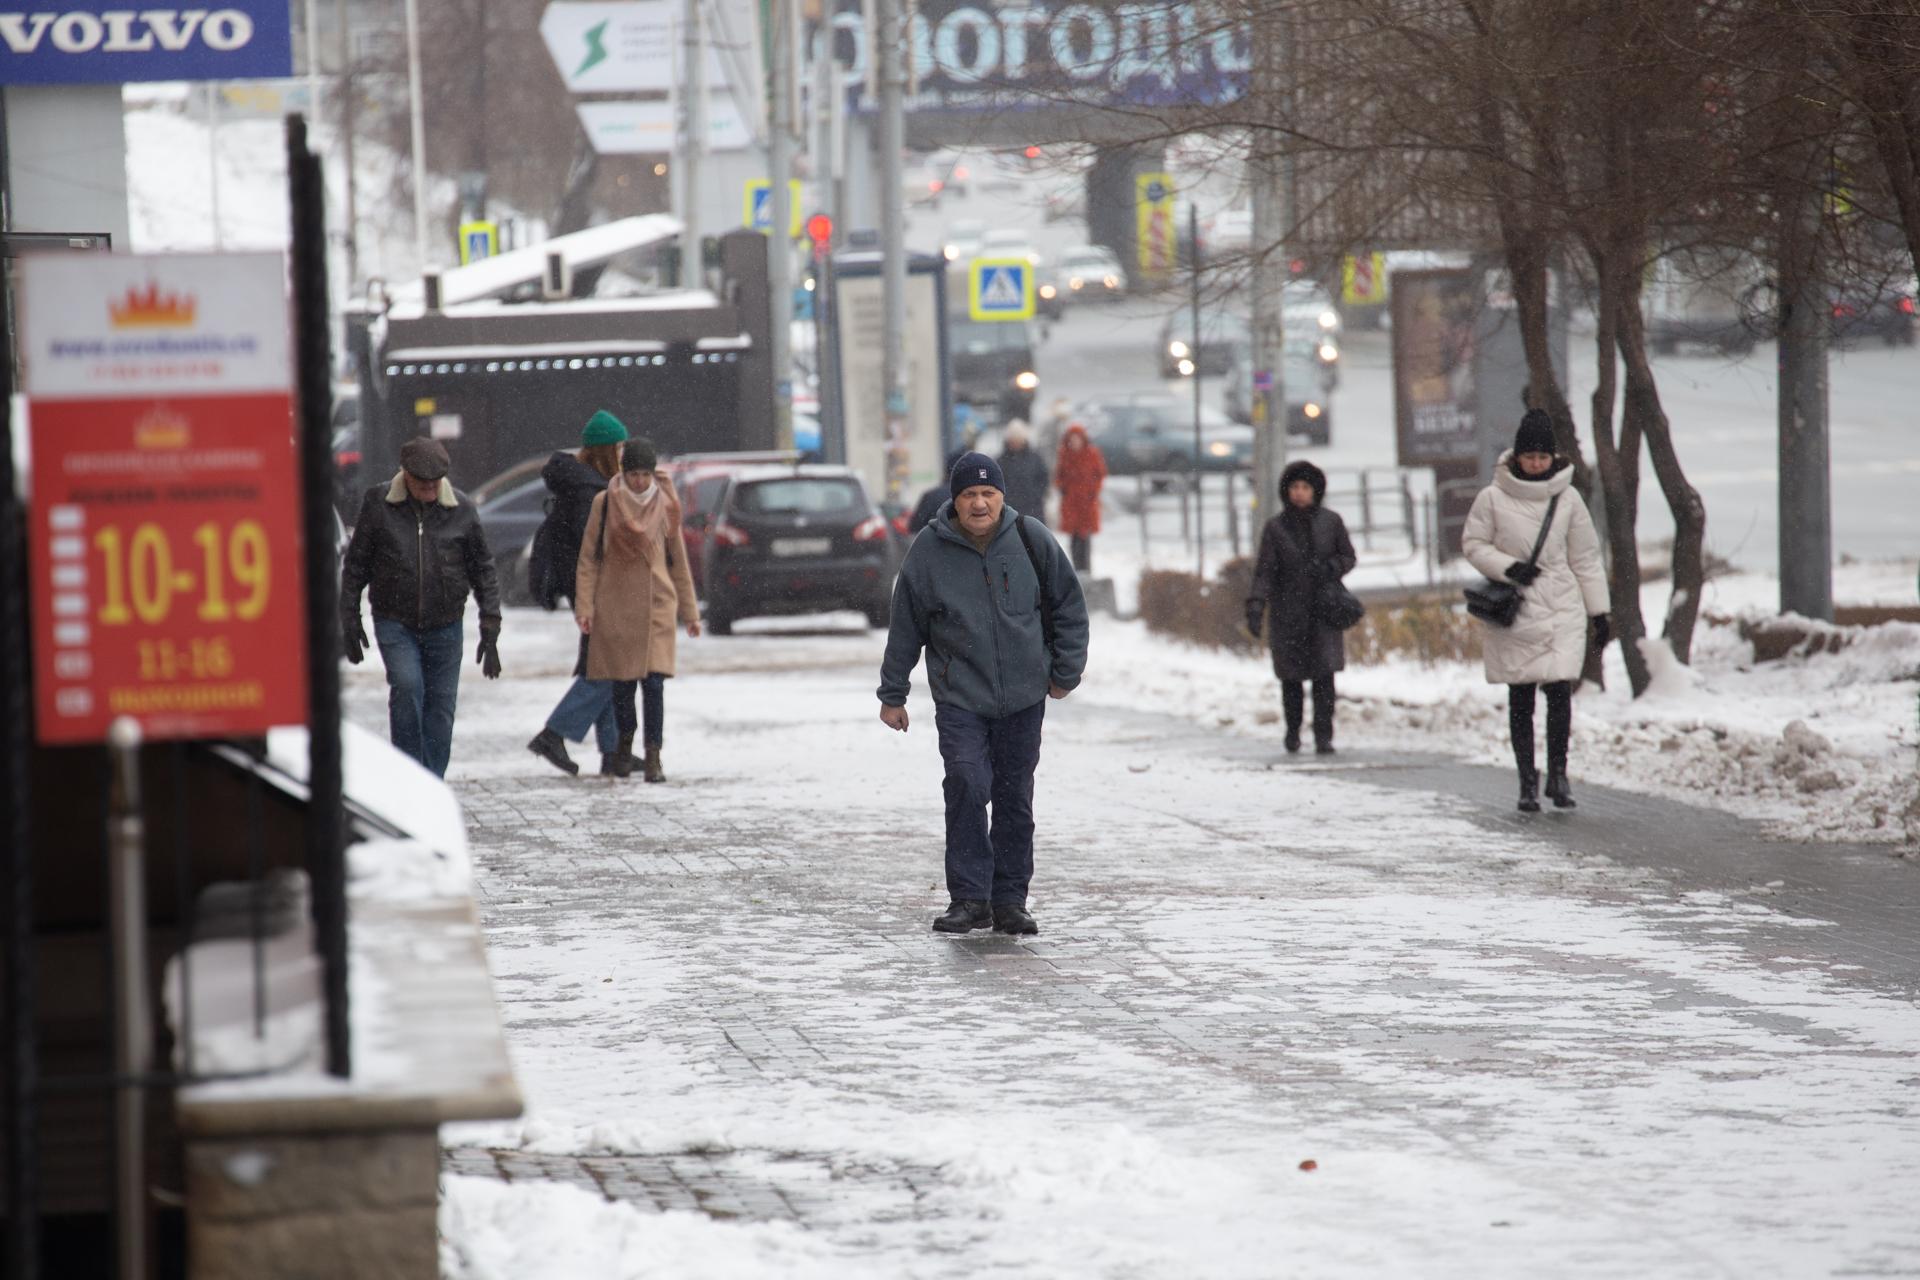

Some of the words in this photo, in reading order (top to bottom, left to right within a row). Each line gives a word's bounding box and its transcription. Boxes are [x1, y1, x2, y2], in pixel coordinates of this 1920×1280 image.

[0, 9, 253, 52] VOLVO
[96, 519, 270, 625] 10-19
[138, 636, 232, 680] 11-16
